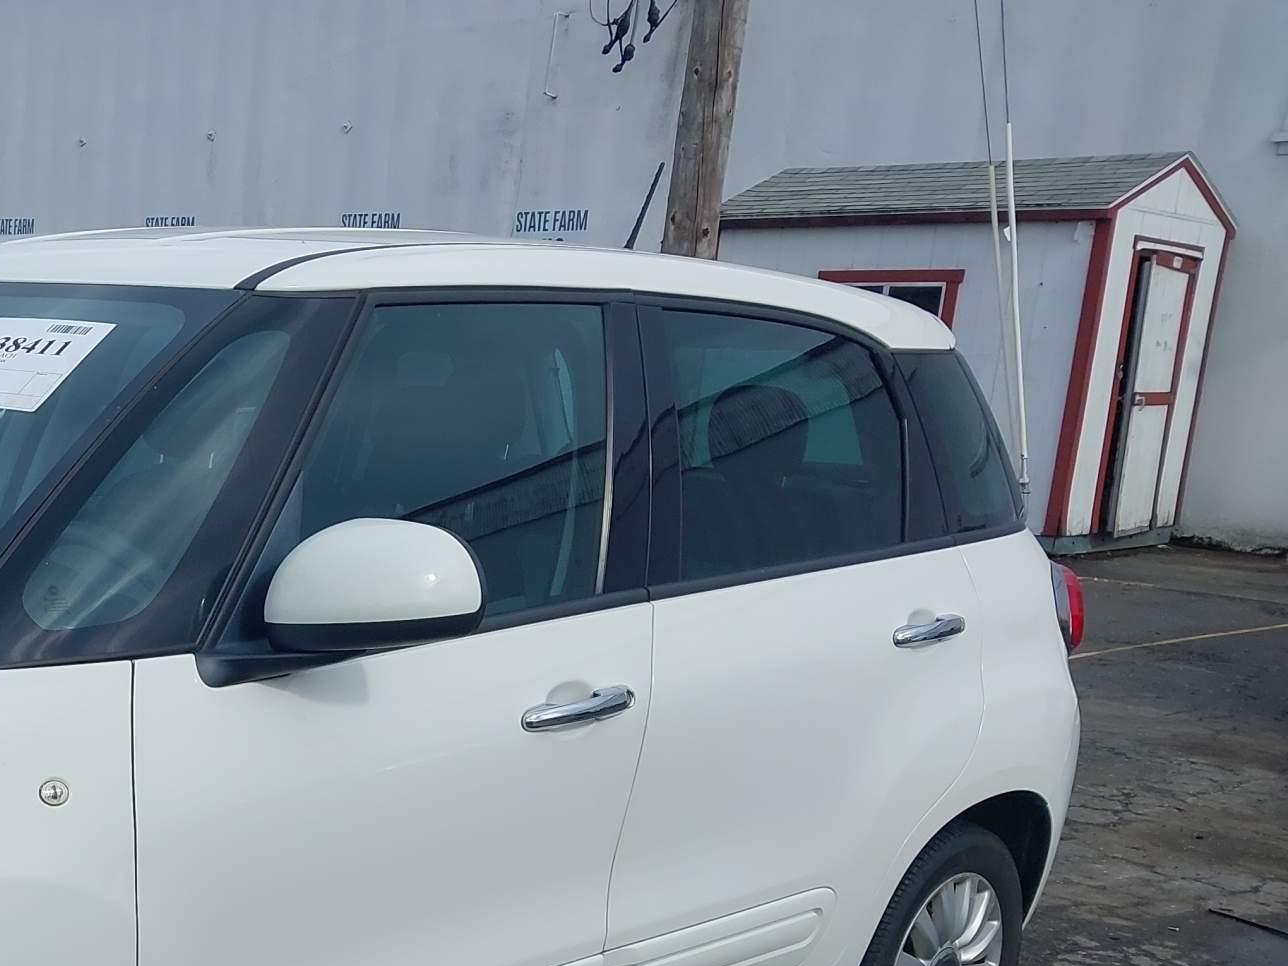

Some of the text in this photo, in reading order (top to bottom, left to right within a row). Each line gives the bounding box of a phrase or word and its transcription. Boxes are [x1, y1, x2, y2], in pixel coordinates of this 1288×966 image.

[13, 218, 35, 235] FARM
[341, 213, 401, 228] STATE FARM
[516, 209, 589, 232] STATE FARM
